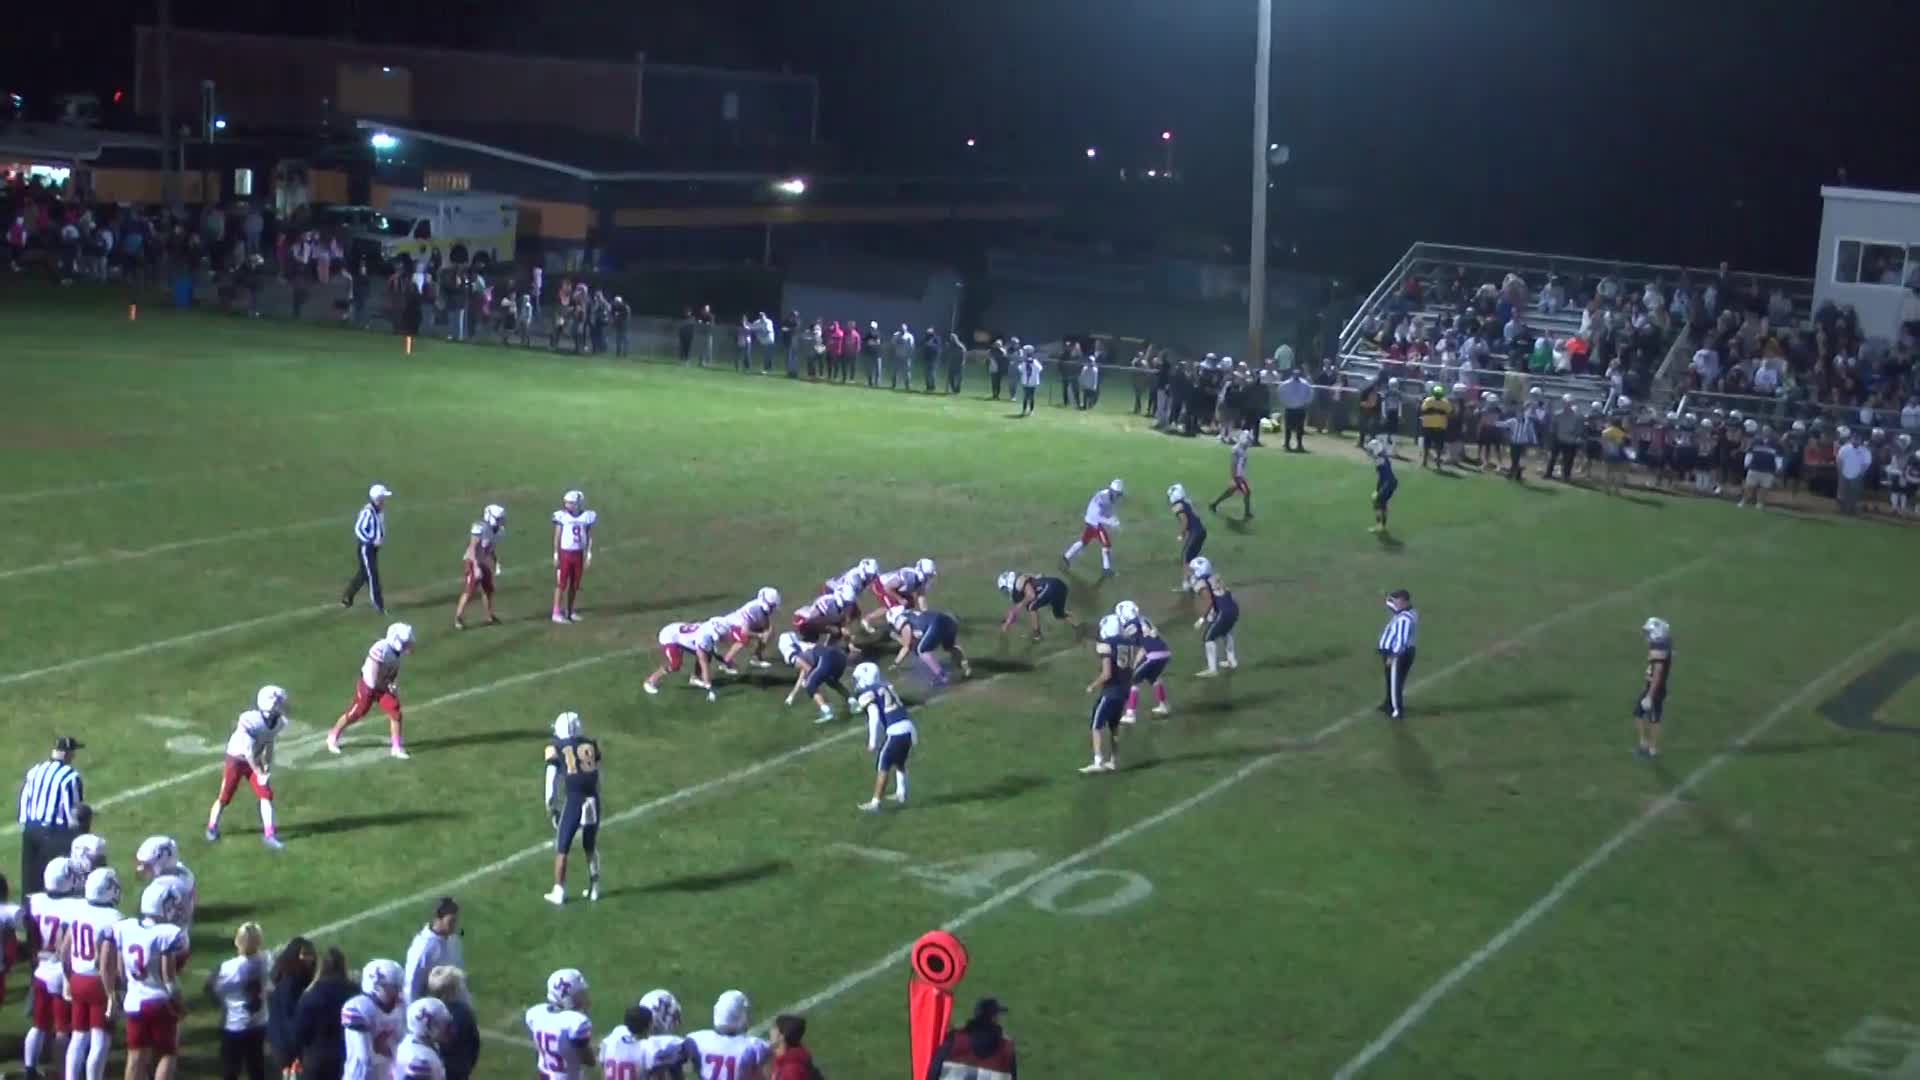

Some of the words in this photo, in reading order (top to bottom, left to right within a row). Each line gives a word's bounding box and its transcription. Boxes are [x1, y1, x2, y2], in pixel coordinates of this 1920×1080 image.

[71, 919, 96, 961] 10
[535, 1030, 565, 1073] 15
[704, 1054, 736, 1080] 71
